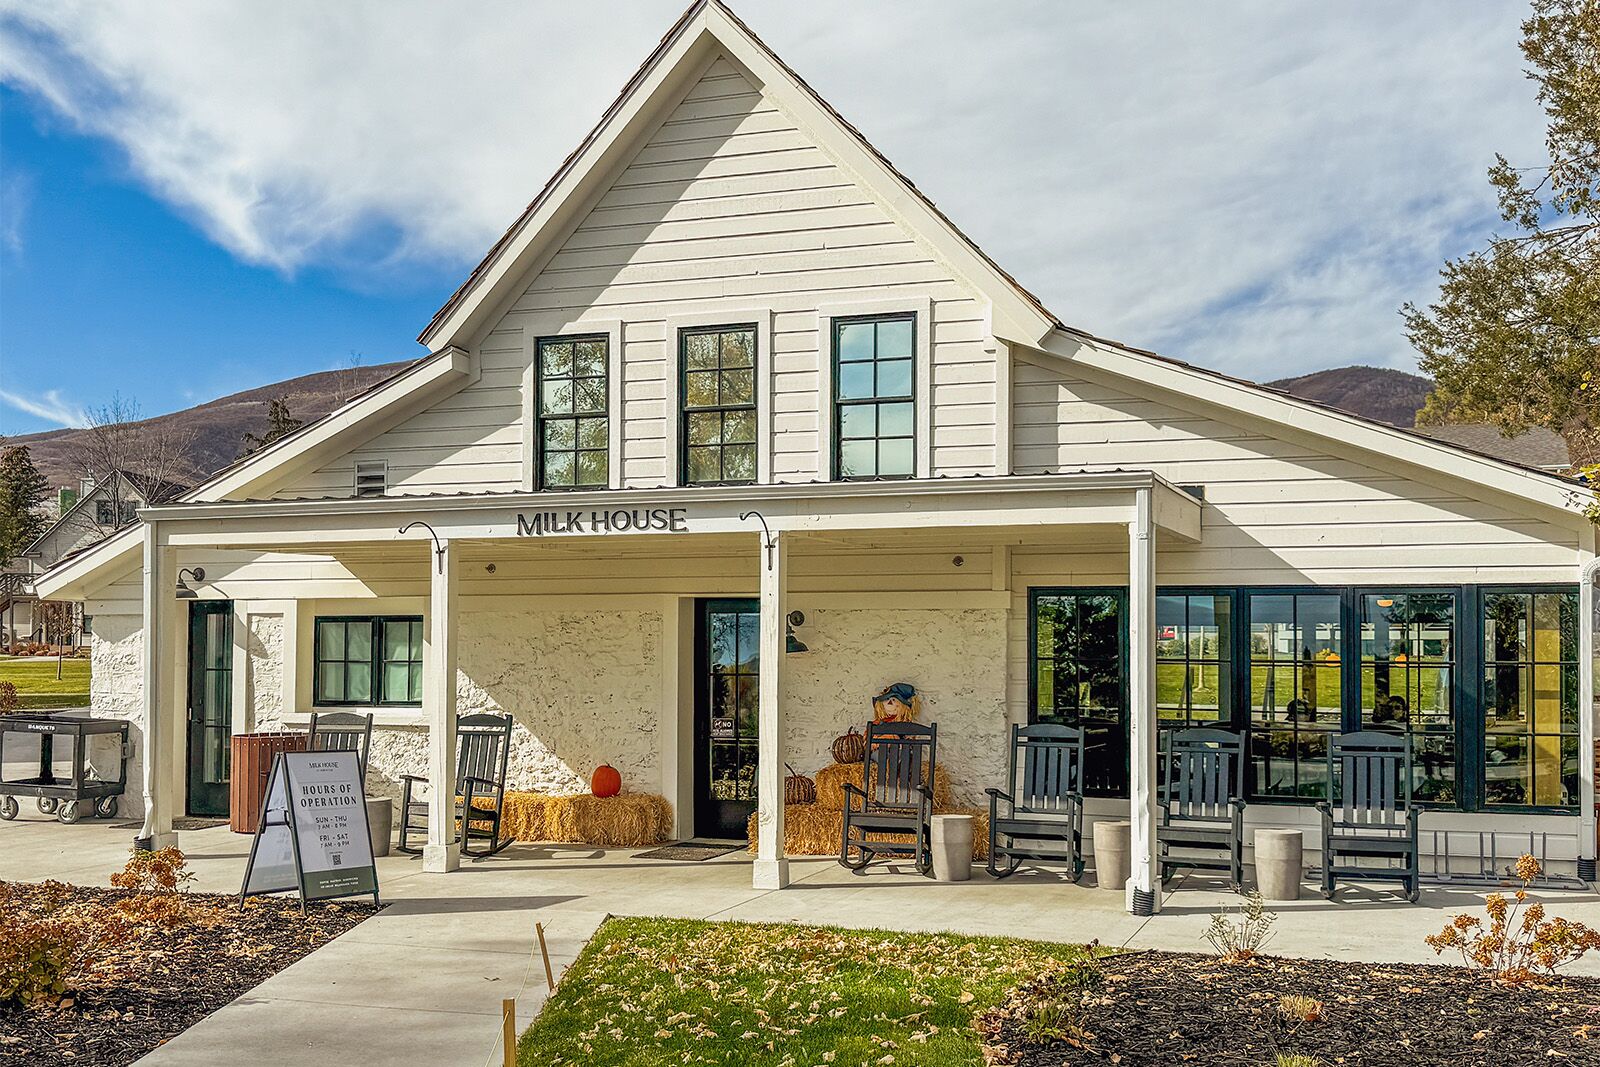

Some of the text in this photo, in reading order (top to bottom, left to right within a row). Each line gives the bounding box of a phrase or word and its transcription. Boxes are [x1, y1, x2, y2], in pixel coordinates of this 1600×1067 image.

[517, 508, 689, 536] MILK HOUSE
[302, 784, 352, 795] HOURS OF
[301, 796, 357, 807] OPERATION
[334, 815, 348, 823] THU
[336, 833, 349, 841] SAT
